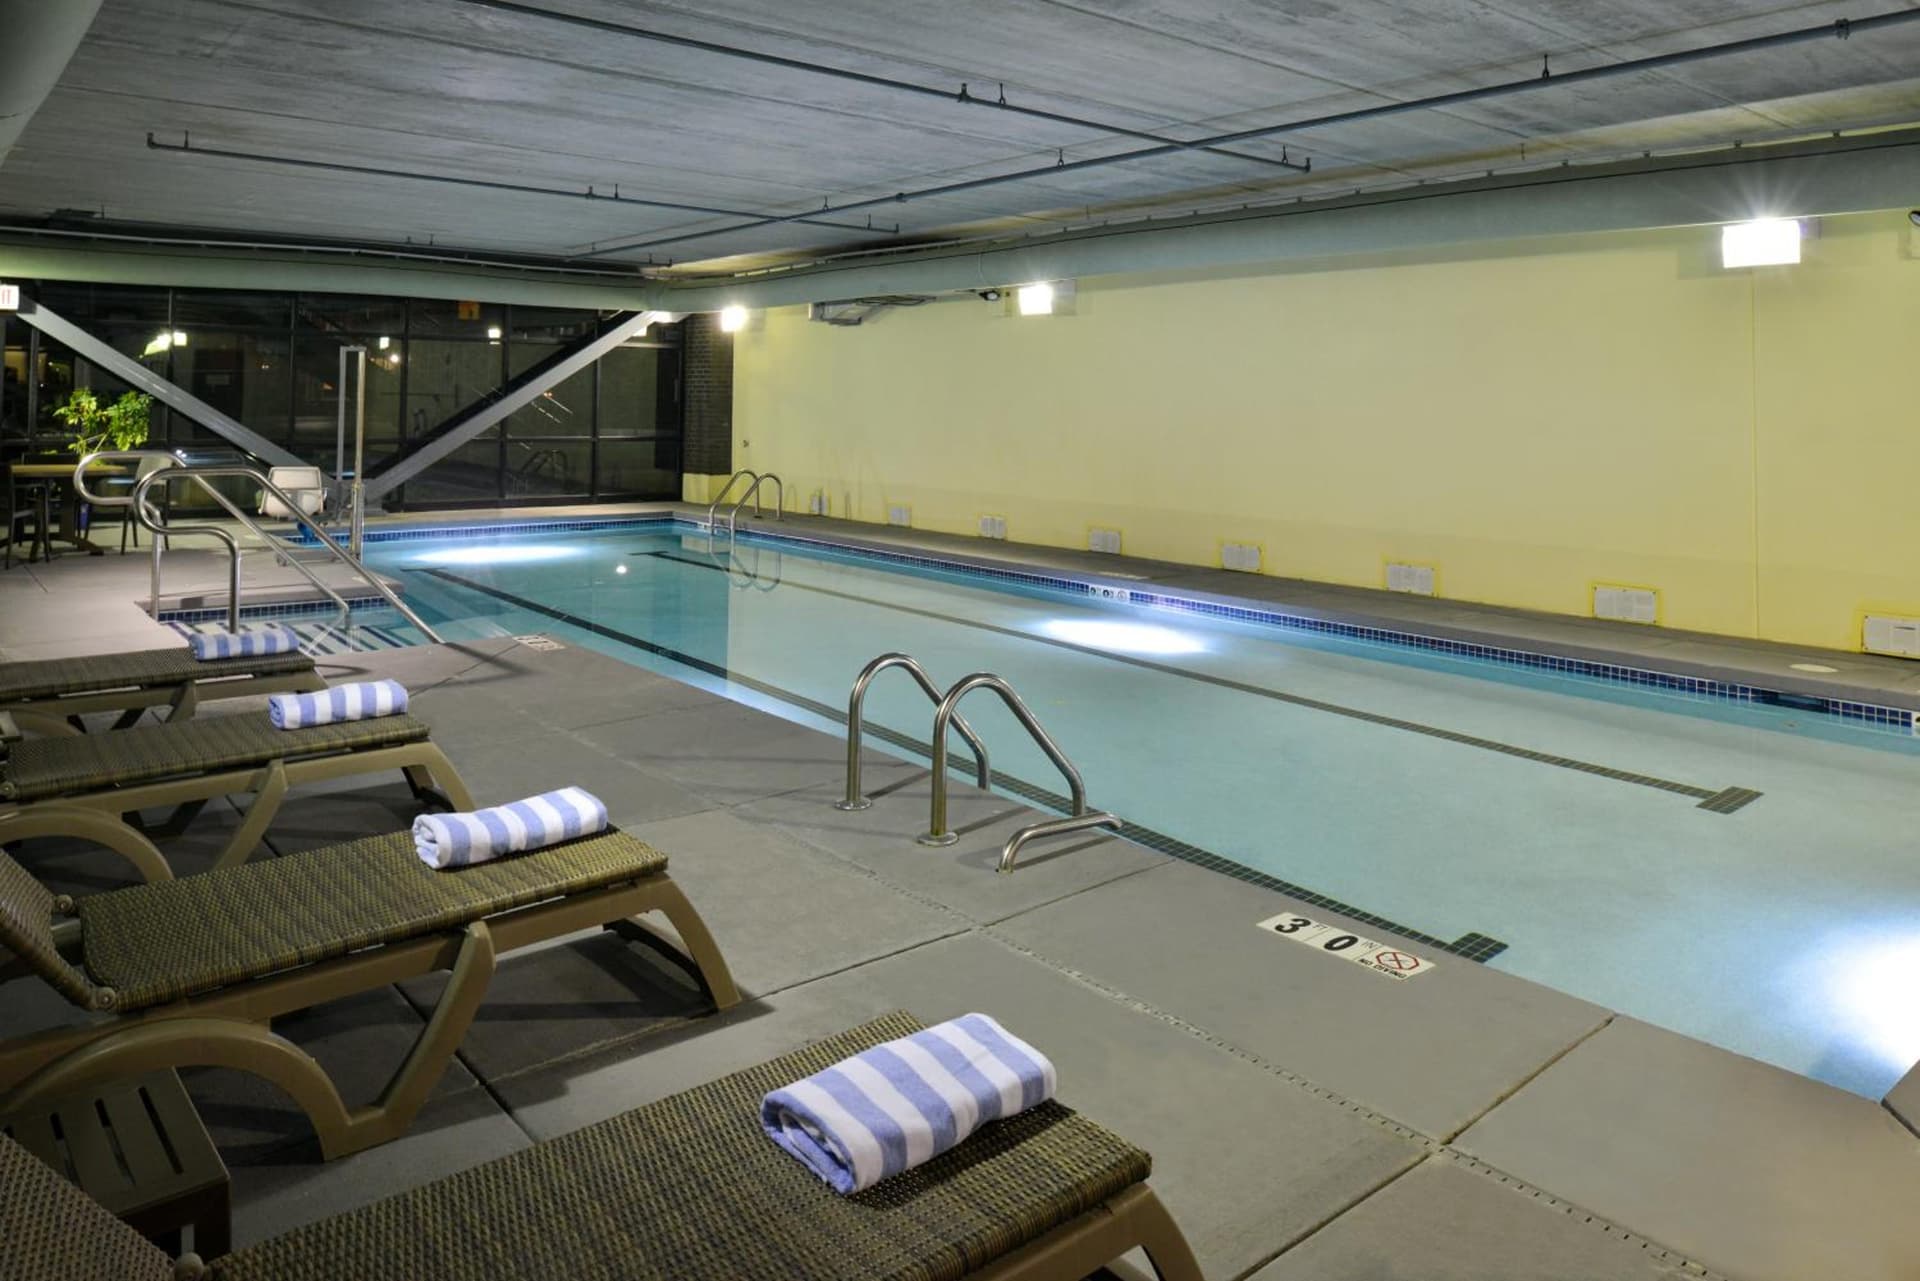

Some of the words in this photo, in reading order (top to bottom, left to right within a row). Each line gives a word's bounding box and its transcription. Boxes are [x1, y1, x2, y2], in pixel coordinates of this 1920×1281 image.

[1275, 918, 1311, 933] 3
[1324, 935, 1358, 951] 0
[1361, 940, 1378, 949] IN
[1374, 965, 1408, 978] DIVING
